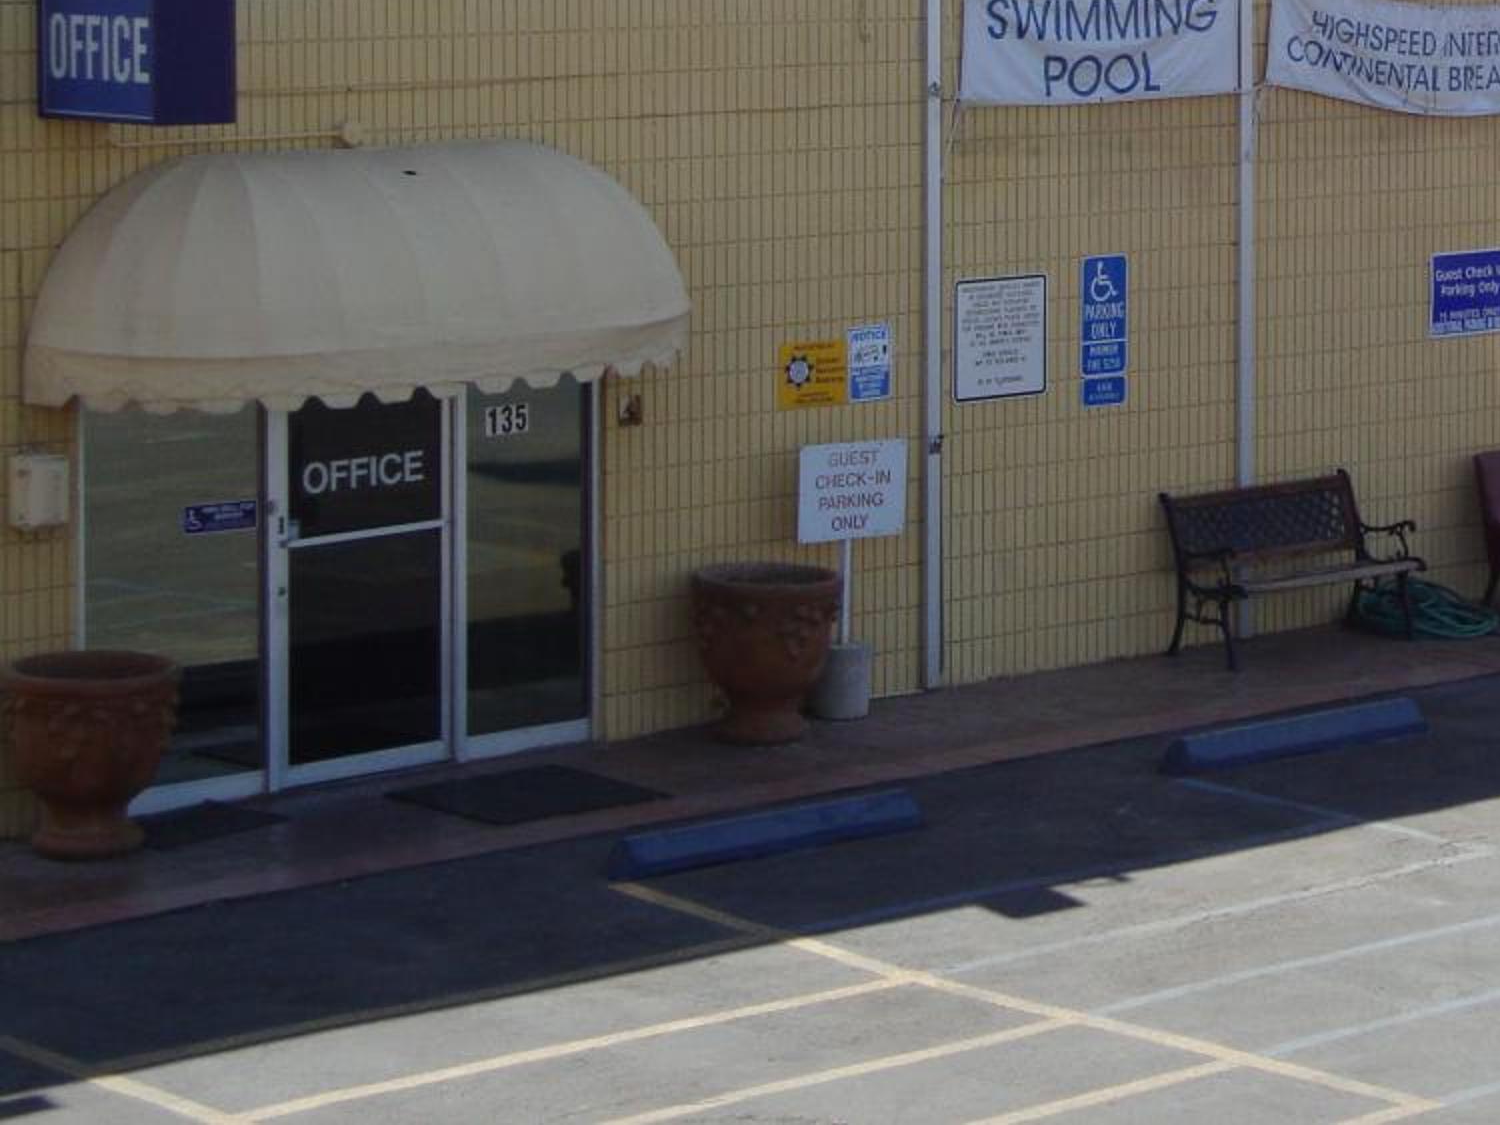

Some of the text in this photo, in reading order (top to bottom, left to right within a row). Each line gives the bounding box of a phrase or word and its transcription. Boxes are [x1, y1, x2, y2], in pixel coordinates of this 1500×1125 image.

[1312, 10, 1437, 57] HIGHSPEED
[50, 13, 150, 84] OFFICE
[1287, 35, 1440, 92] CONTINENTAL
[1043, 51, 1161, 97] POOL
[1436, 268, 1462, 281] Guest
[1478, 280, 1500, 295] Only
[1085, 303, 1124, 320] PARKING
[1091, 322, 1117, 339] ONLY
[488, 405, 527, 434] 135
[829, 450, 880, 467] GUEST
[302, 450, 424, 494] OFFICE
[815, 469, 891, 489] CHECK-IN
[819, 492, 884, 510] PARKING
[832, 514, 868, 531] ONLY
